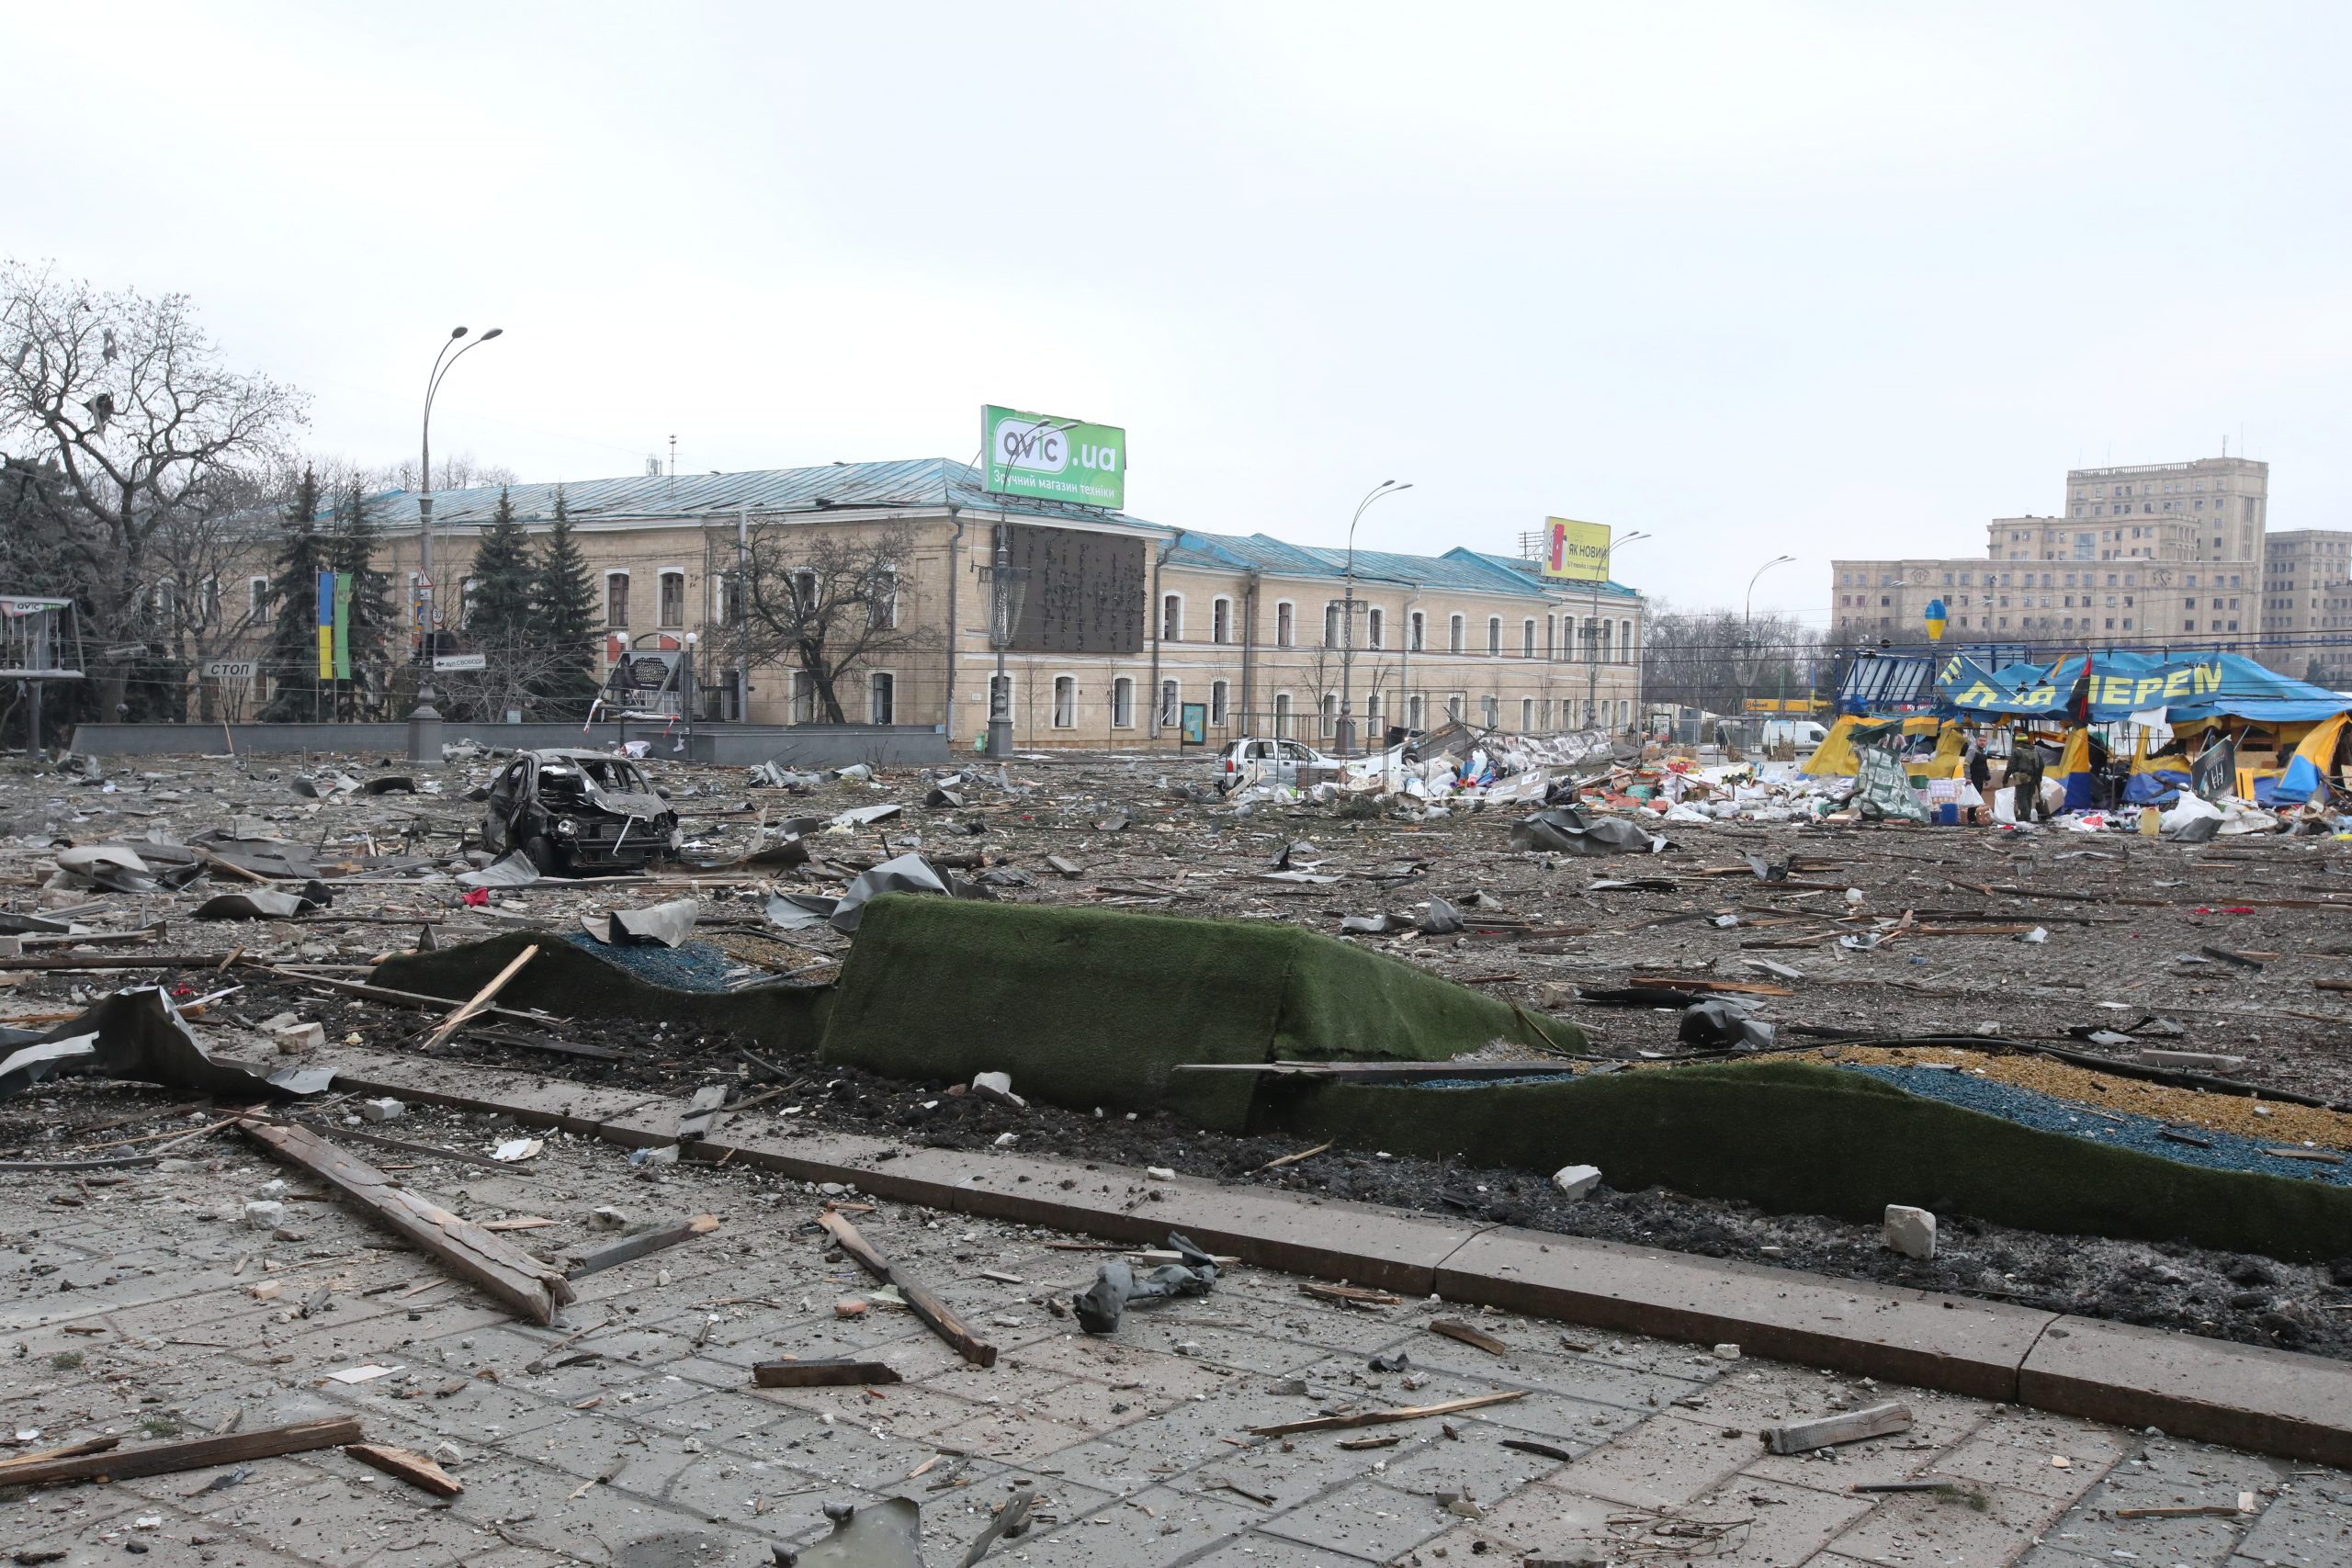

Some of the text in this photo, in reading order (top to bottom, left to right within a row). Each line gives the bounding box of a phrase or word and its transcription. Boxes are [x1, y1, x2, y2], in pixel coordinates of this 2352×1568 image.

[1003, 429, 1058, 462] avic
[994, 469, 1114, 499] Зручний магазин техніки
[1568, 543, 1608, 559] ЯК НОВИЙ
[211, 664, 249, 675] СТОП
